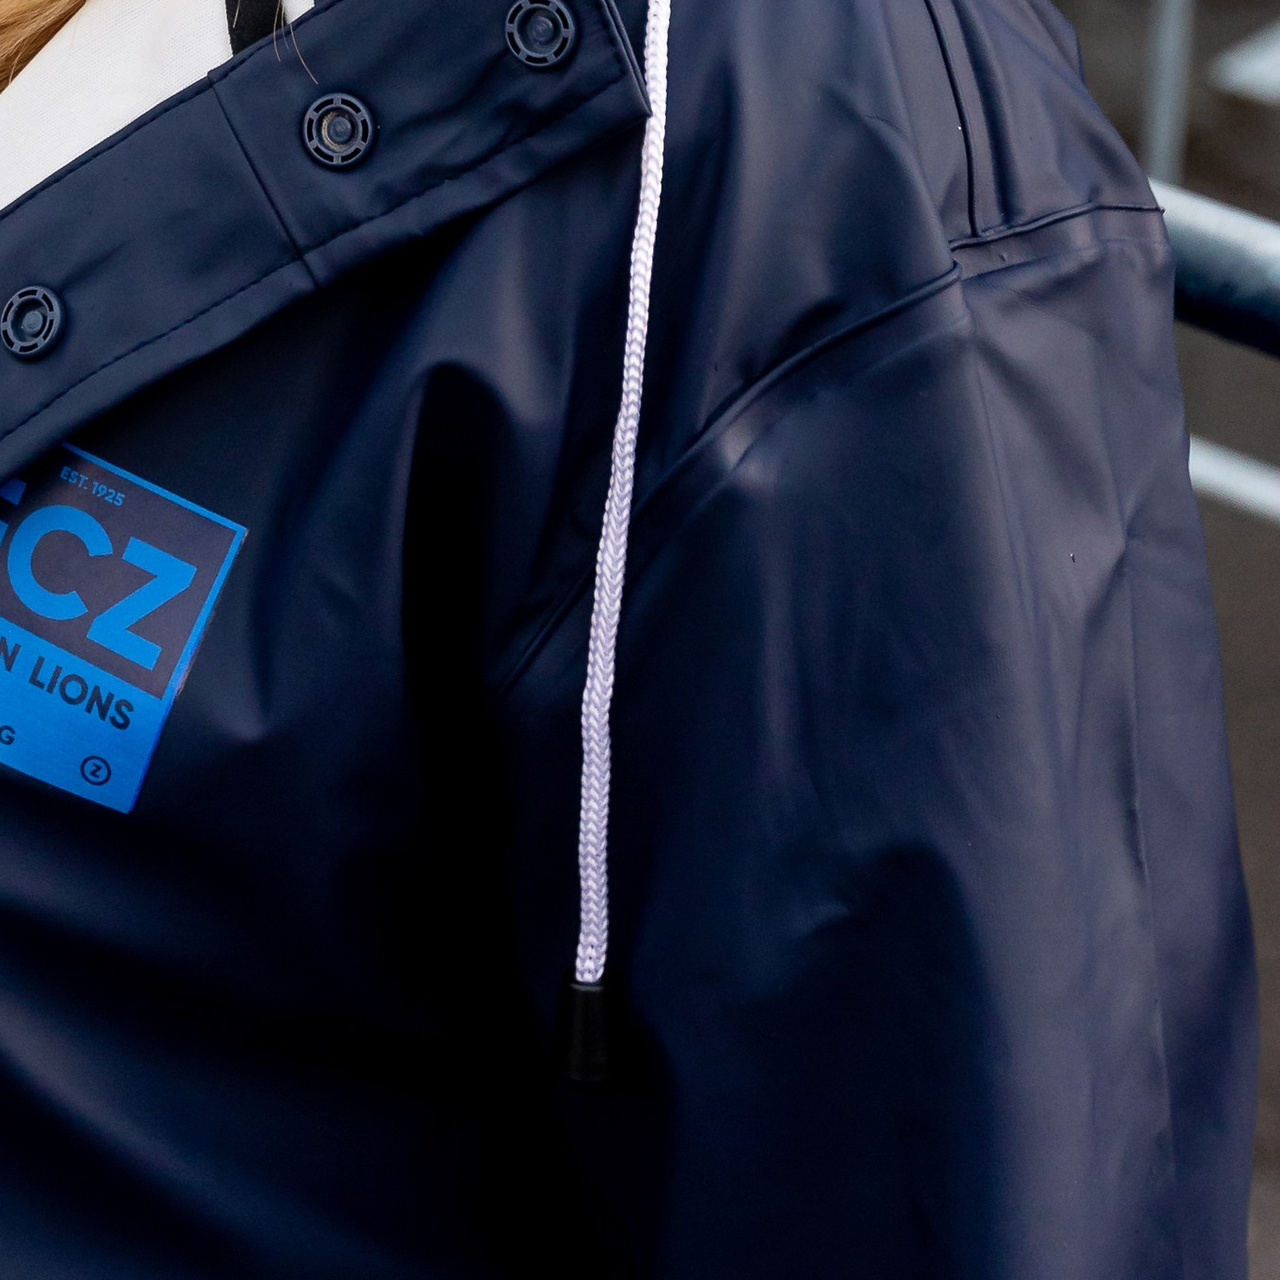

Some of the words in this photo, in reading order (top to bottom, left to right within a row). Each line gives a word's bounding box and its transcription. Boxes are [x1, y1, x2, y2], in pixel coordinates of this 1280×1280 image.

[59, 466, 88, 491] EST.
[91, 479, 125, 507] 1925
[28, 656, 134, 731] LIONS
